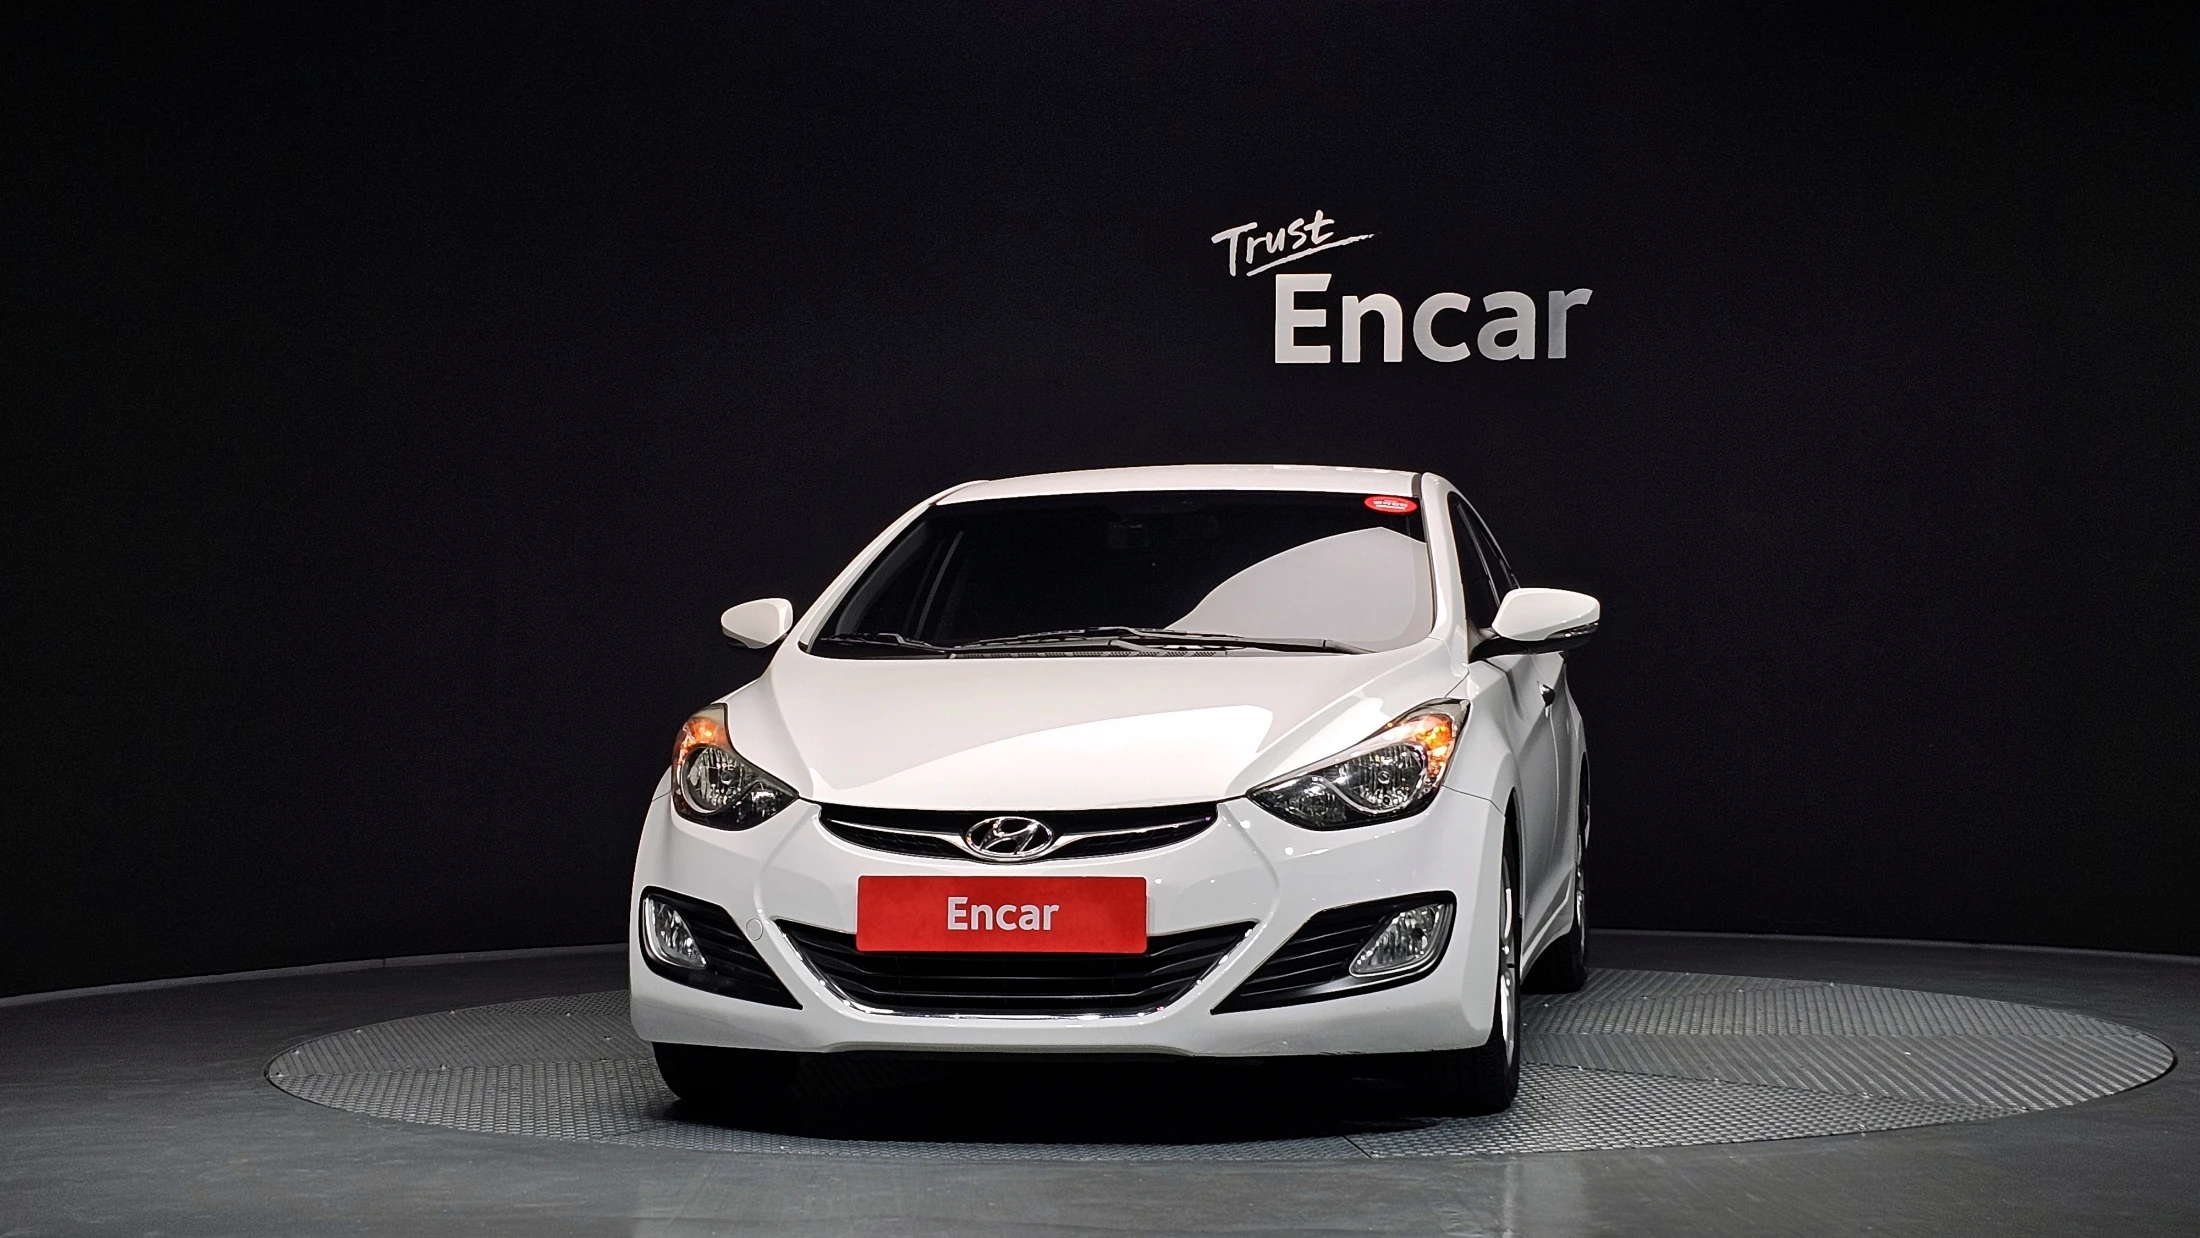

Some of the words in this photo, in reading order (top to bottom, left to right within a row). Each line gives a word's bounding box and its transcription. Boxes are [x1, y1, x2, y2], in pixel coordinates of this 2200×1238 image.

[1211, 209, 1335, 277] Trust
[1275, 273, 1594, 364] Encar
[947, 896, 1060, 931] Encar
